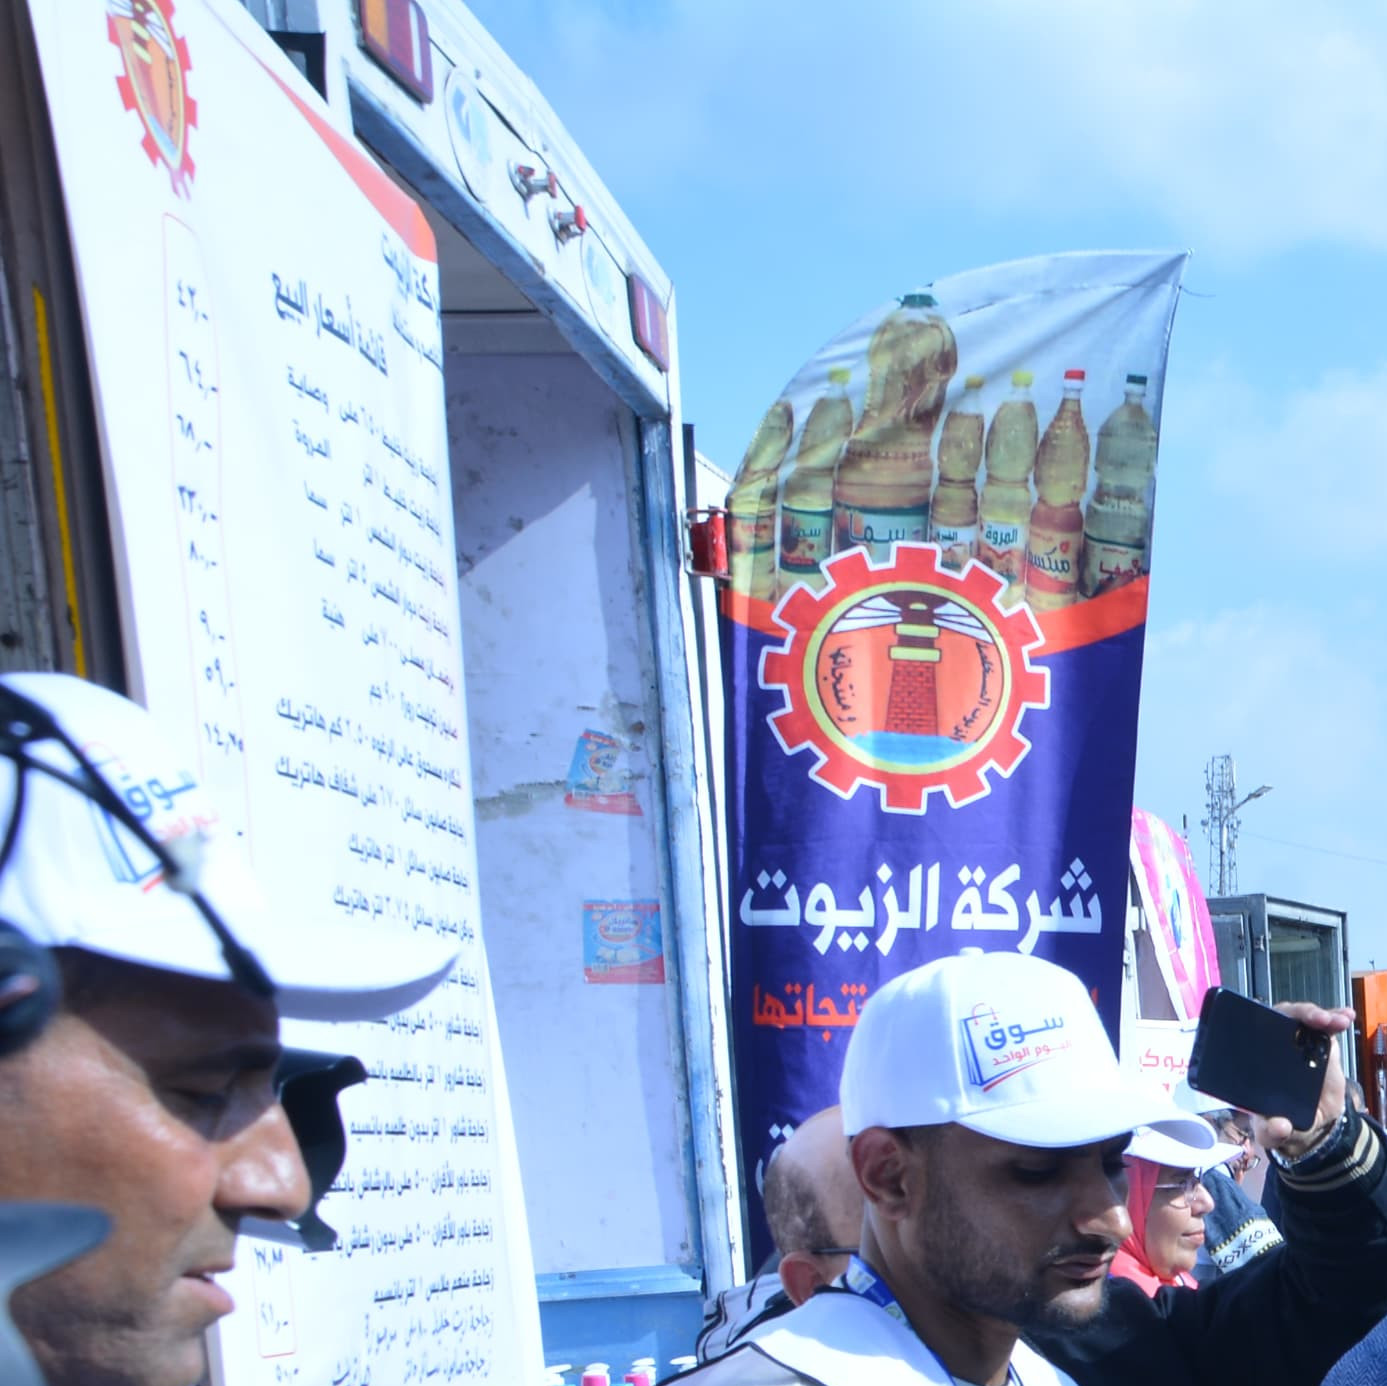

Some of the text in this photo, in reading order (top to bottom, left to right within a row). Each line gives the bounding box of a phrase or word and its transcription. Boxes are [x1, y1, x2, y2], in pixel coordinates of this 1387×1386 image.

[270, 271, 310, 325] البيع
[312, 292, 356, 349] أسعار
[355, 320, 389, 378] قائمة
[850, 512, 907, 543] سما
[275, 697, 328, 733] هاتريك
[275, 755, 327, 790] هاتريك
[739, 857, 1102, 956] شركة الزيوت
[984, 1016, 1065, 1050] سوق
[992, 1048, 1030, 1066] الواحد
